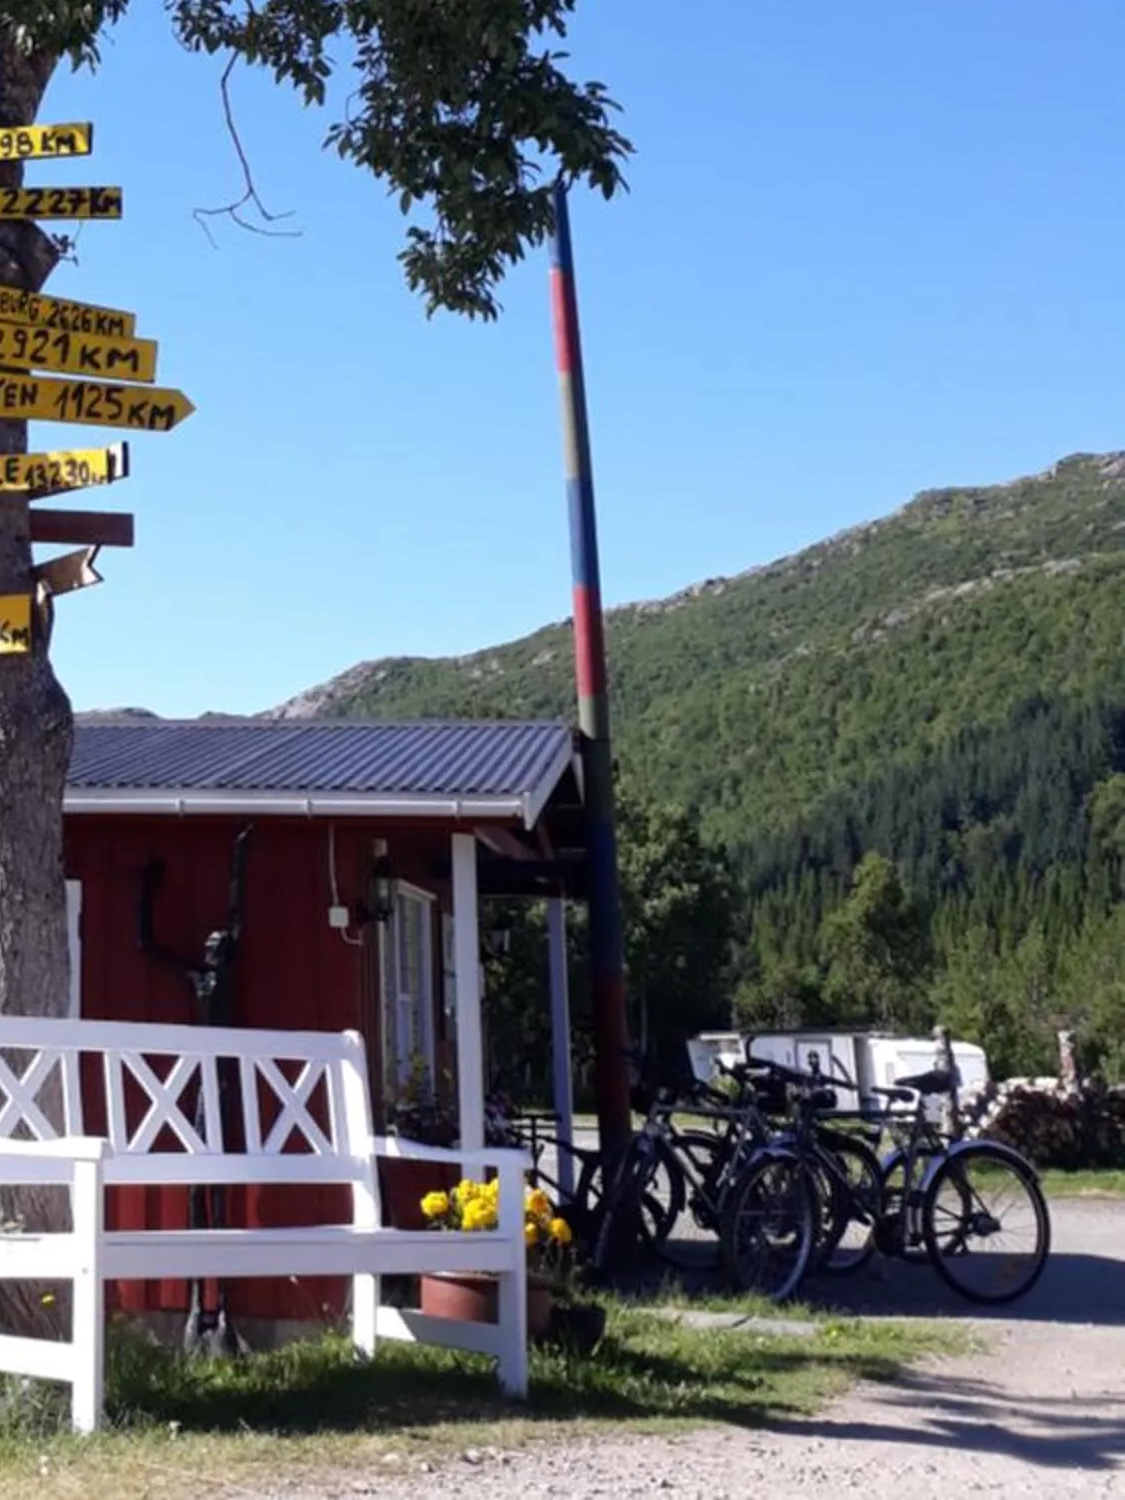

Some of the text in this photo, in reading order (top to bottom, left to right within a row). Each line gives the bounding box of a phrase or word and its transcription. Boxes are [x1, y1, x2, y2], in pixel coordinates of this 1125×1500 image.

[40, 129, 78, 153] KM
[2, 189, 86, 216] 2227
[94, 312, 125, 337] KM
[80, 344, 140, 372] KM
[55, 386, 125, 422] 1125
[127, 401, 176, 431] KM
